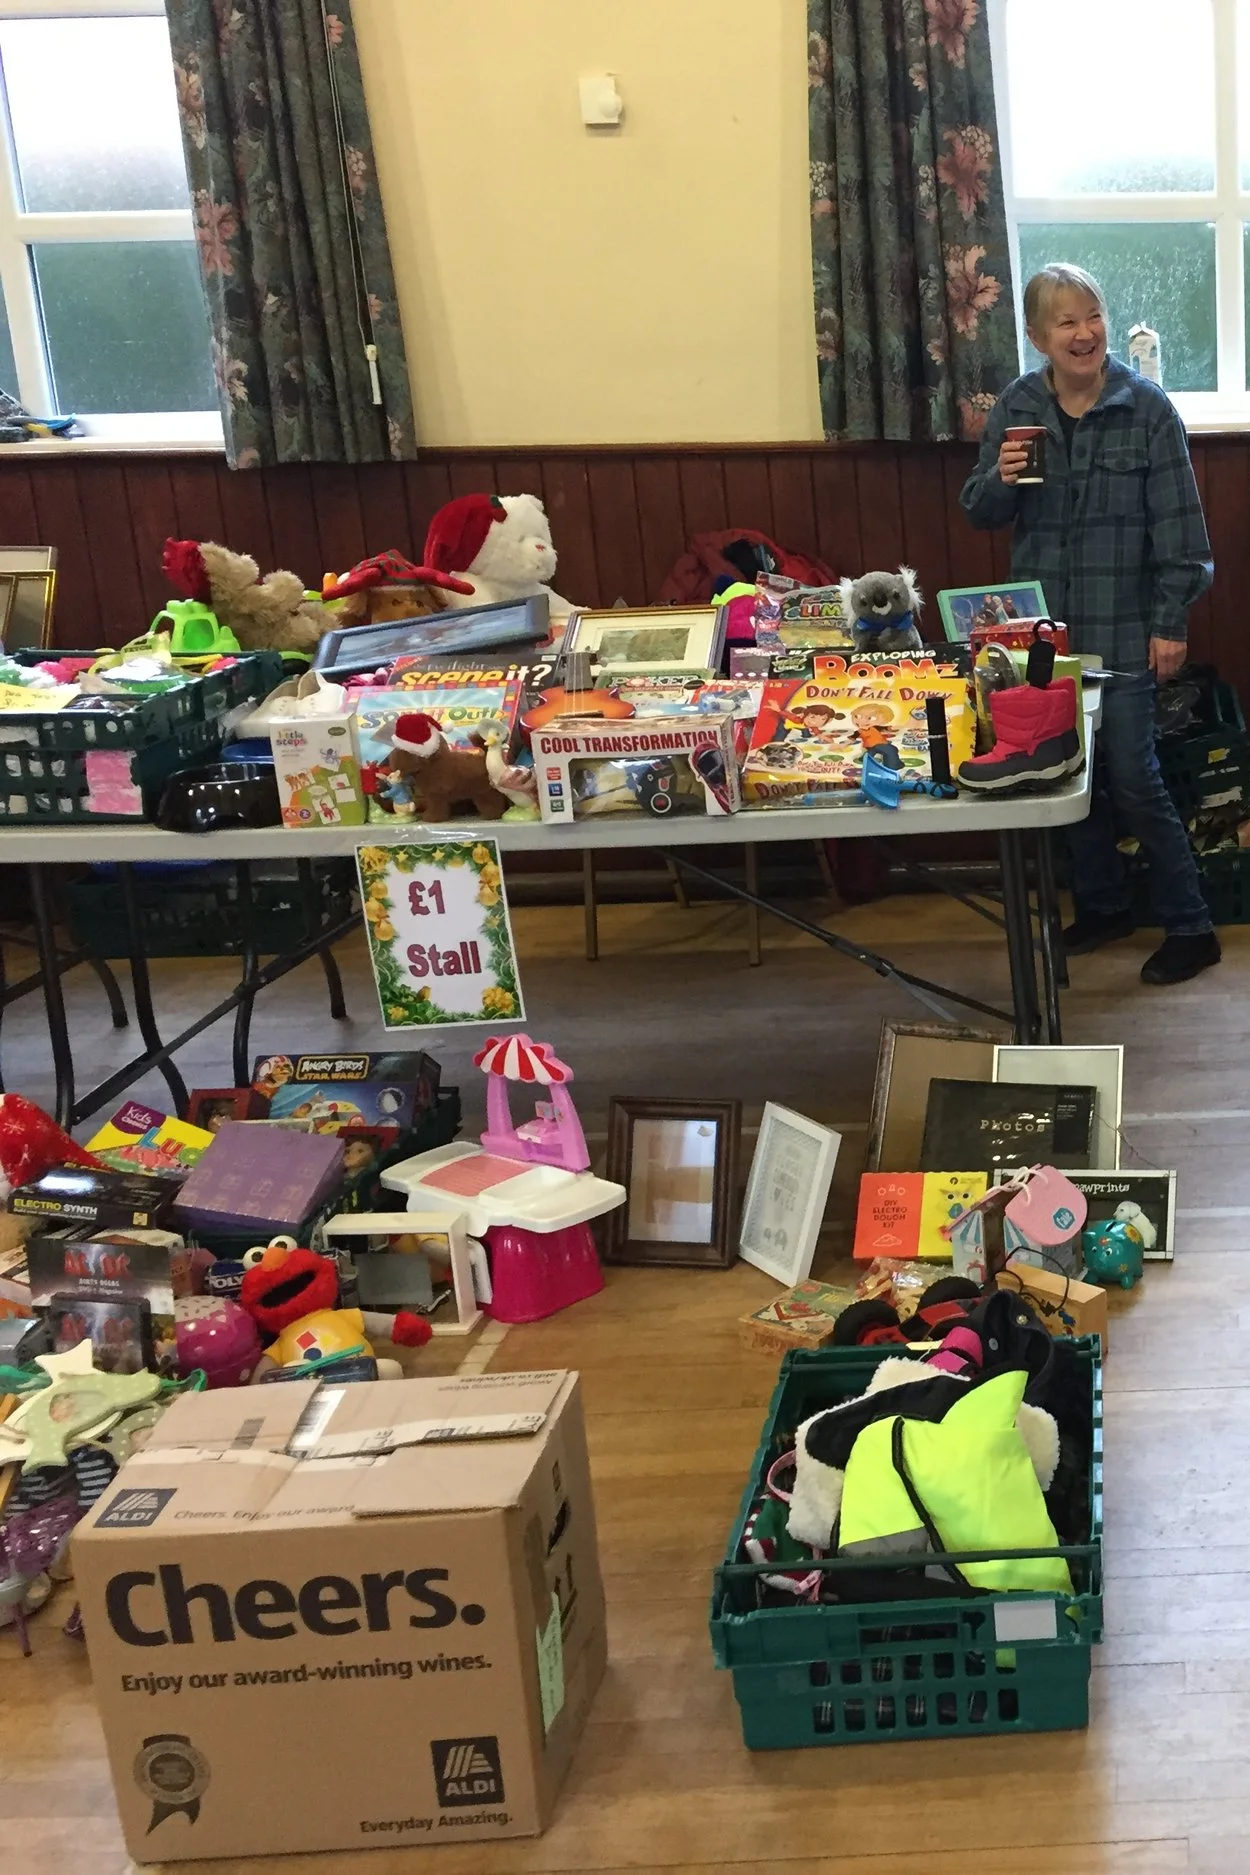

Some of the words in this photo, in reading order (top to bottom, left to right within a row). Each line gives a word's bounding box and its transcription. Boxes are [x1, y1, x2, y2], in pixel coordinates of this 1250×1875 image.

[851, 650, 936, 663] EXPLODING
[806, 684, 855, 699] DON'T
[858, 686, 892, 700] FALL
[900, 687, 954, 701] DOWN
[540, 736, 581, 755] COOL
[584, 730, 718, 753] TRANSFORMATION
[408, 879, 446, 916] £1
[406, 940, 482, 978] Stall
[301, 1060, 334, 1073] ANGRY
[335, 1059, 364, 1072] BIRDS
[126, 1106, 152, 1124] Kids
[980, 1119, 1045, 1132] Photos
[14, 1198, 62, 1211] ELECTRO
[63, 1203, 98, 1215] SYNTH
[104, 1511, 153, 1522] ALDI
[174, 1510, 228, 1520] Cheers.
[234, 1509, 275, 1522] Enjoy
[275, 1508, 302, 1516] our
[105, 1563, 486, 1647] Cheers.
[121, 1674, 184, 1697] Enjoy
[189, 1673, 228, 1689] our
[234, 1657, 413, 1687] award-winning
[417, 1652, 493, 1674] wines.
[444, 1778, 497, 1797] ALDI
[359, 1816, 433, 1834] Everyday
[437, 1810, 514, 1826] Amazing.
